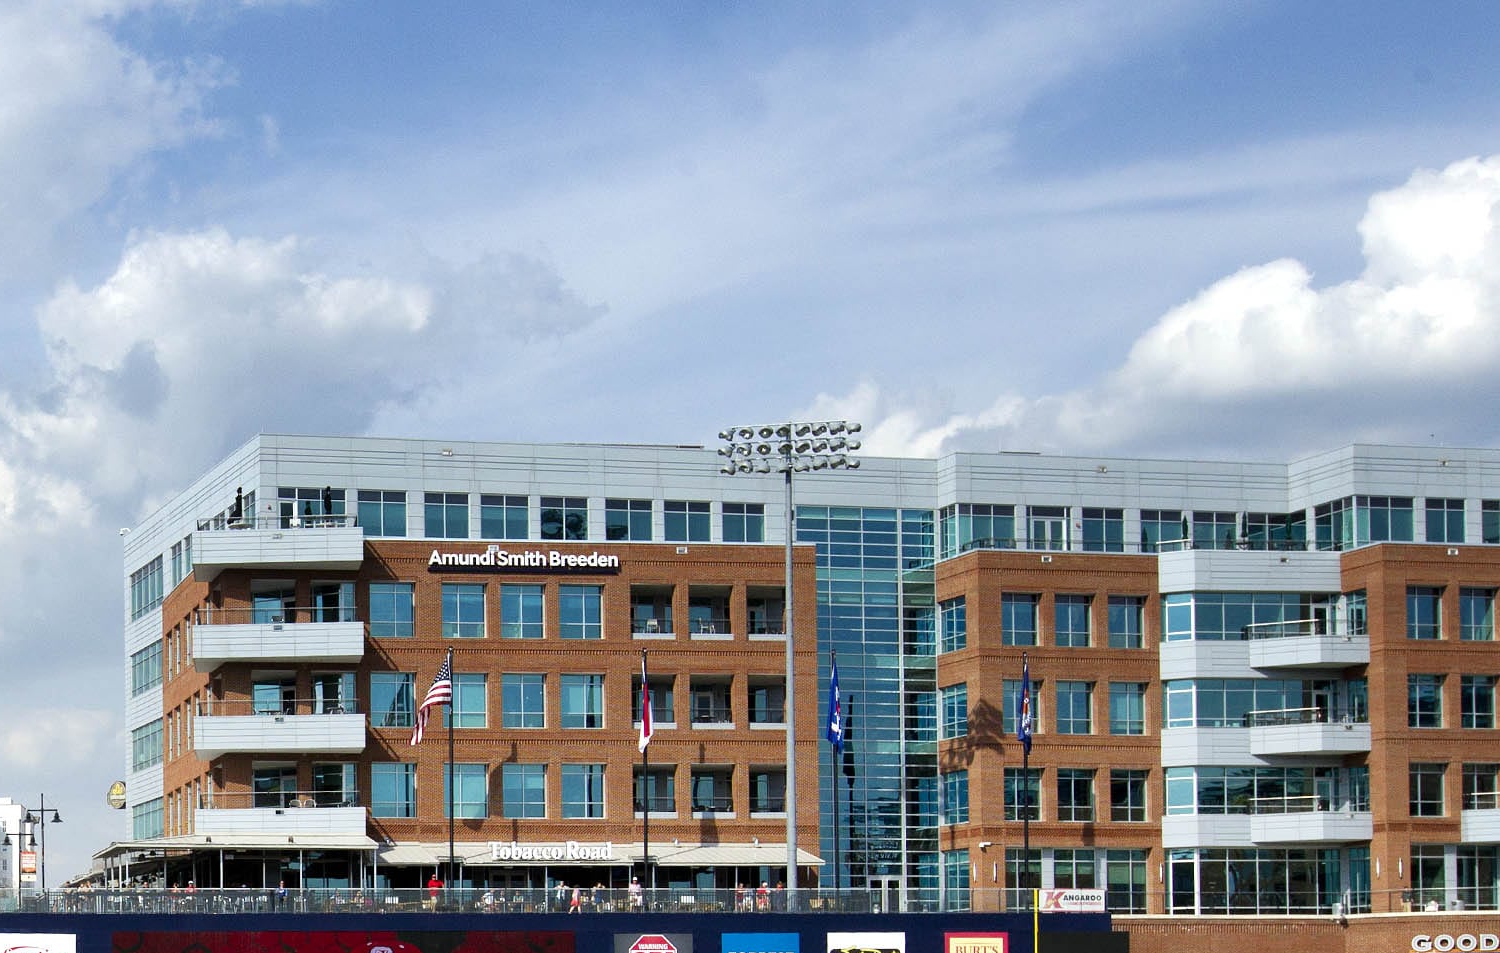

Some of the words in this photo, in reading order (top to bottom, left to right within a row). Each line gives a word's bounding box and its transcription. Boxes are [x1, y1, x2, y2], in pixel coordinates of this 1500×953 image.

[428, 550, 495, 567] Amundi
[497, 550, 547, 567] Smith
[550, 551, 619, 567] Breeden
[487, 841, 564, 860] Tobacco
[565, 841, 612, 860] Road
[1411, 934, 1500, 952] GOOD
